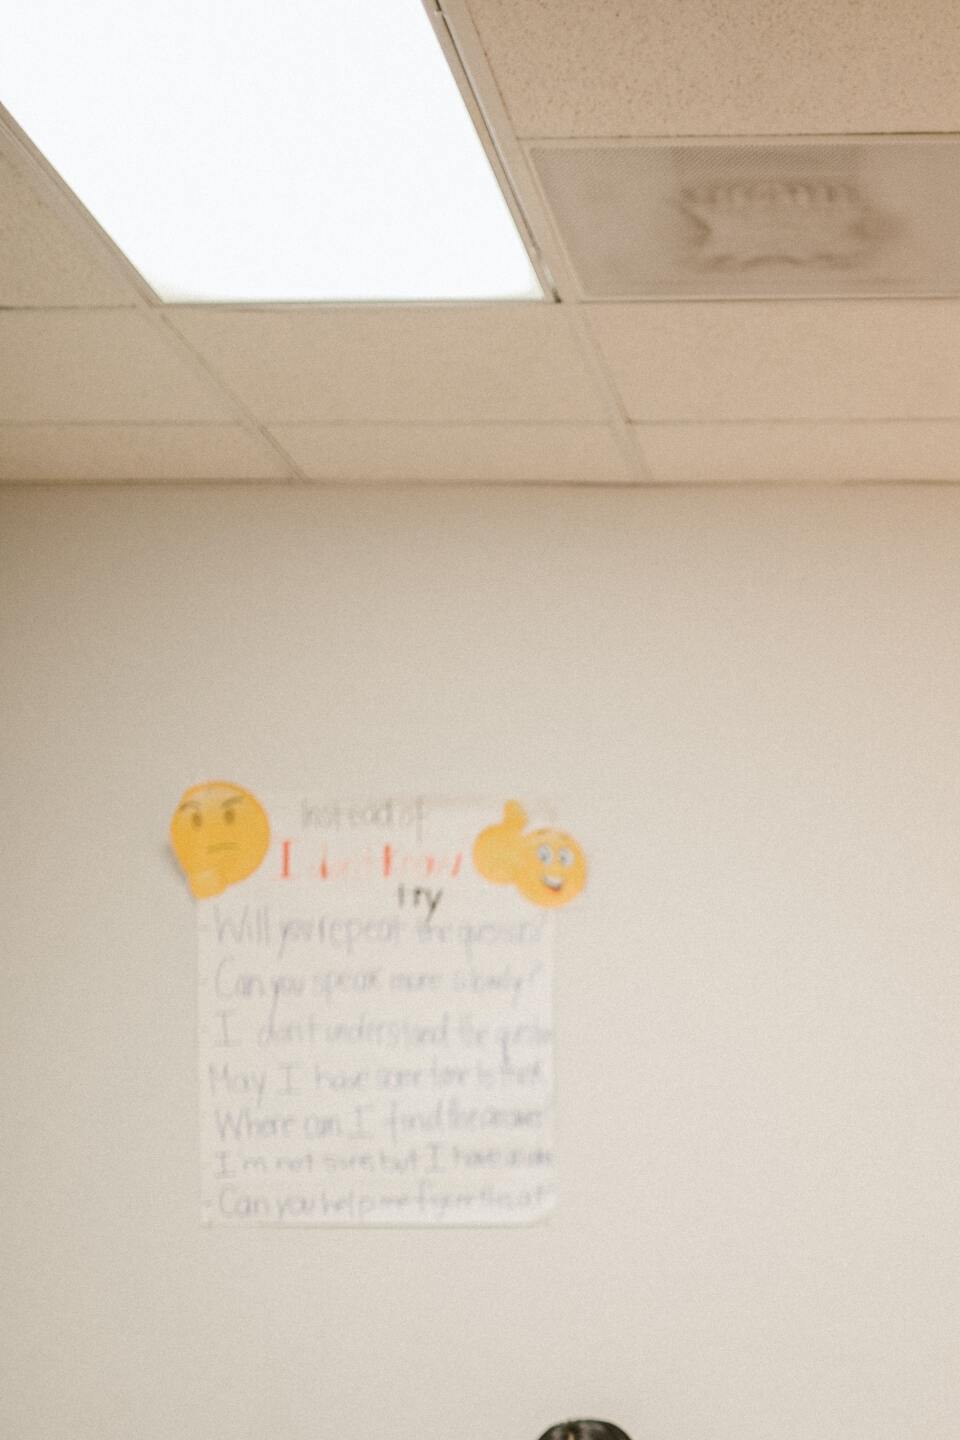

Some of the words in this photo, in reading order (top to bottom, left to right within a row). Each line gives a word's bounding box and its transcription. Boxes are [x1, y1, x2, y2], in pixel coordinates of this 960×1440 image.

[213, 904, 270, 946] Will
[214, 954, 266, 999] Can
[270, 973, 305, 1014] you
[212, 1009, 244, 1048] I
[207, 1062, 268, 1109] May
[276, 1062, 304, 1097] I
[213, 1106, 297, 1142] Where
[346, 1104, 376, 1141] I
[424, 1141, 448, 1175] I
[218, 1182, 271, 1219] Can
[276, 1193, 316, 1222] you
